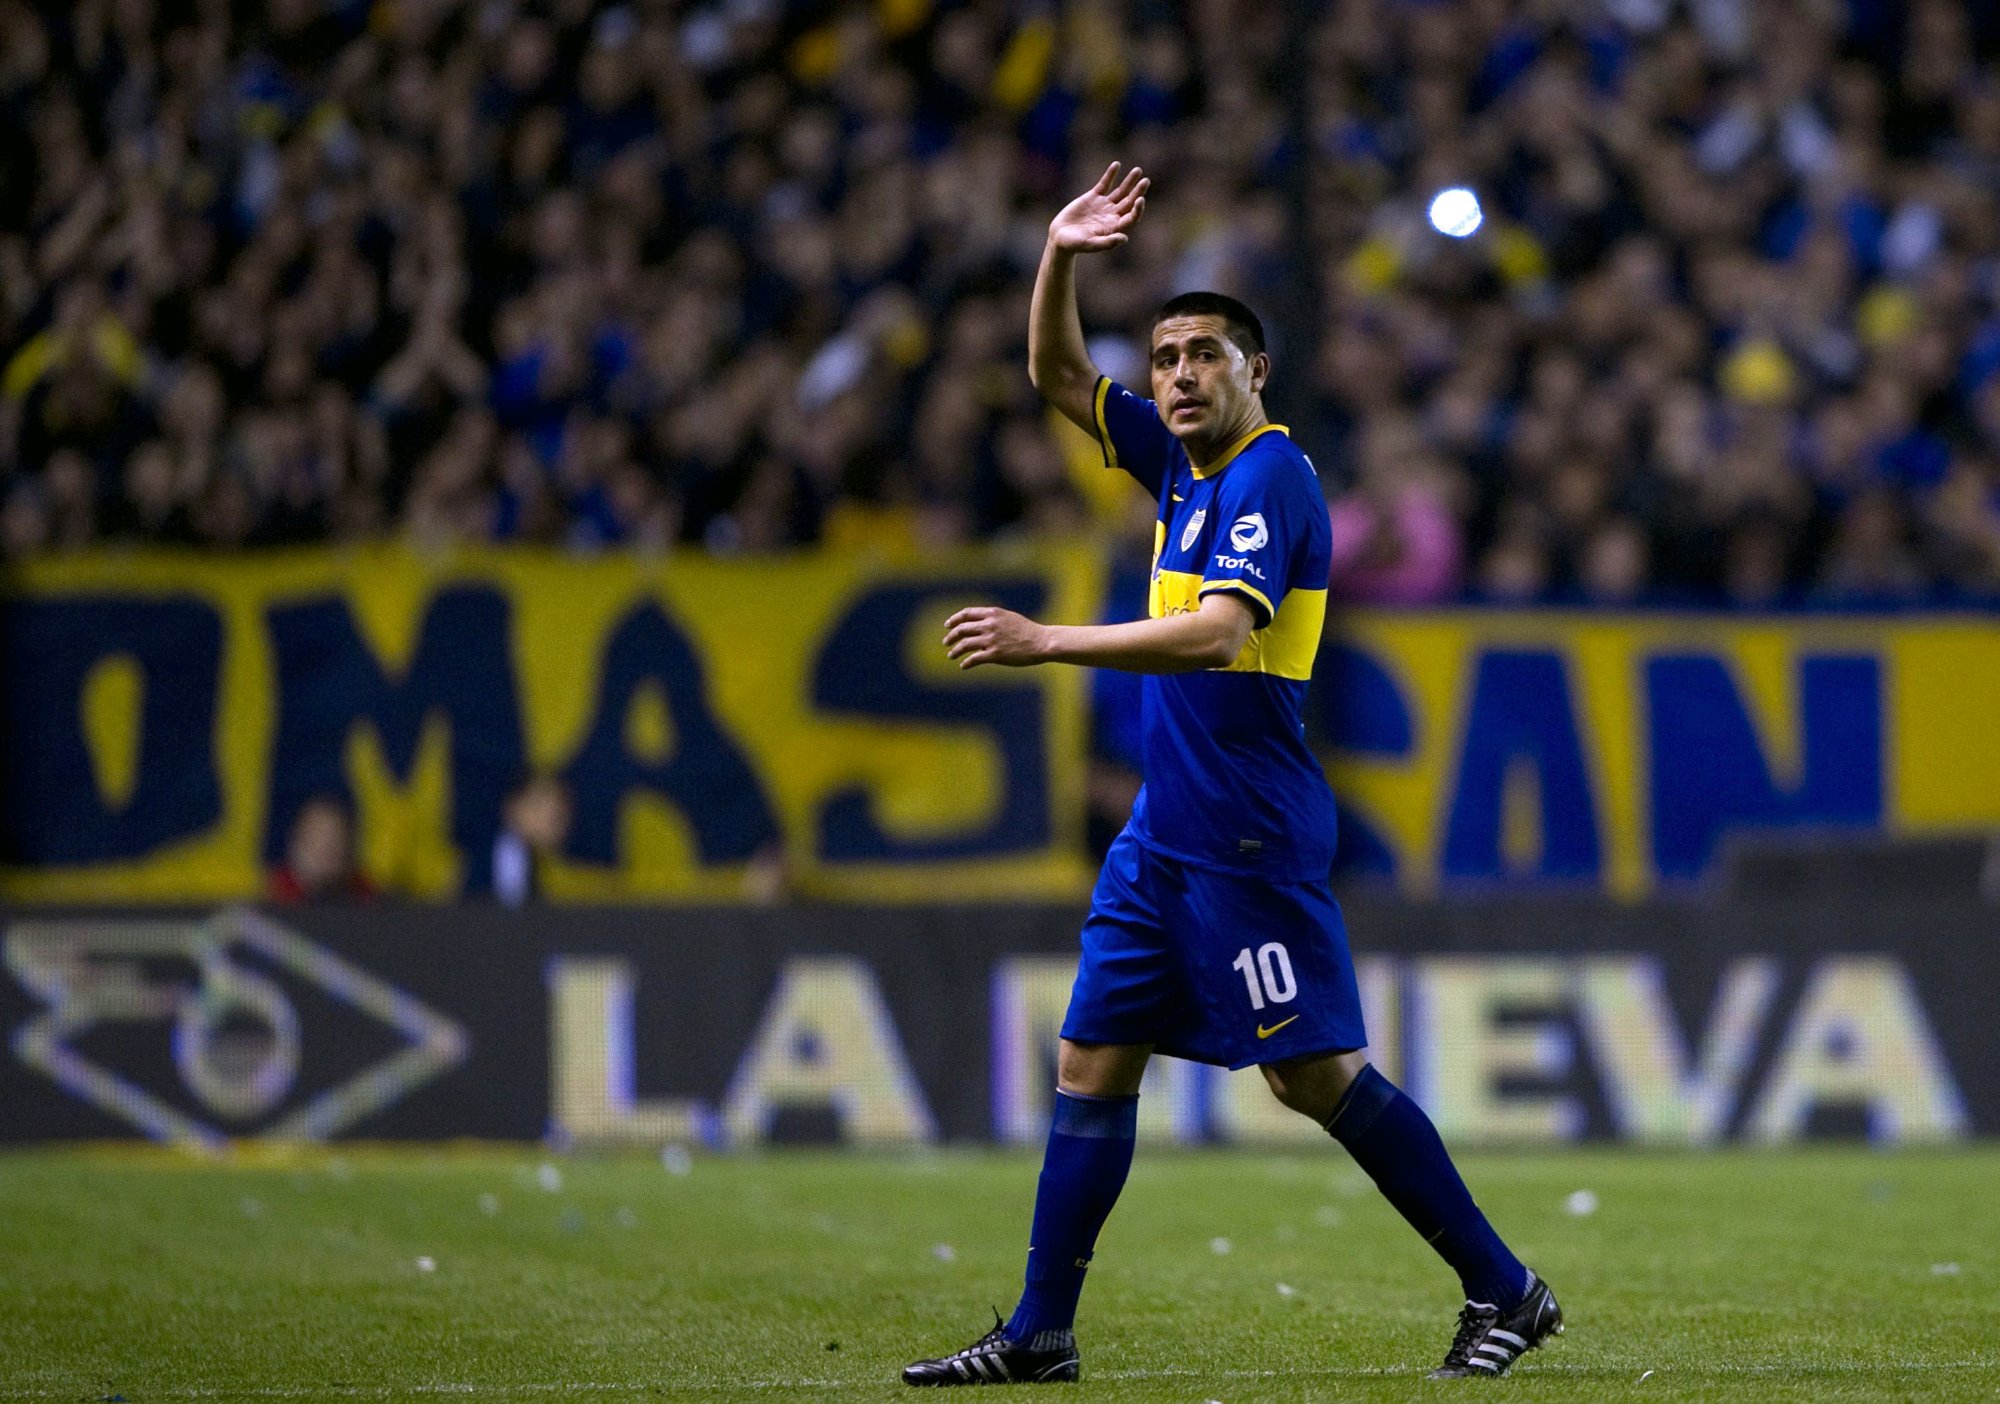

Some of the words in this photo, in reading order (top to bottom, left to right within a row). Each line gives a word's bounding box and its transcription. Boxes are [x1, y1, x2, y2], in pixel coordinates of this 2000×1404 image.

[1214, 554, 1267, 580] TOTAL
[1232, 941, 1298, 1011] 10
[544, 955, 938, 1145] LA
